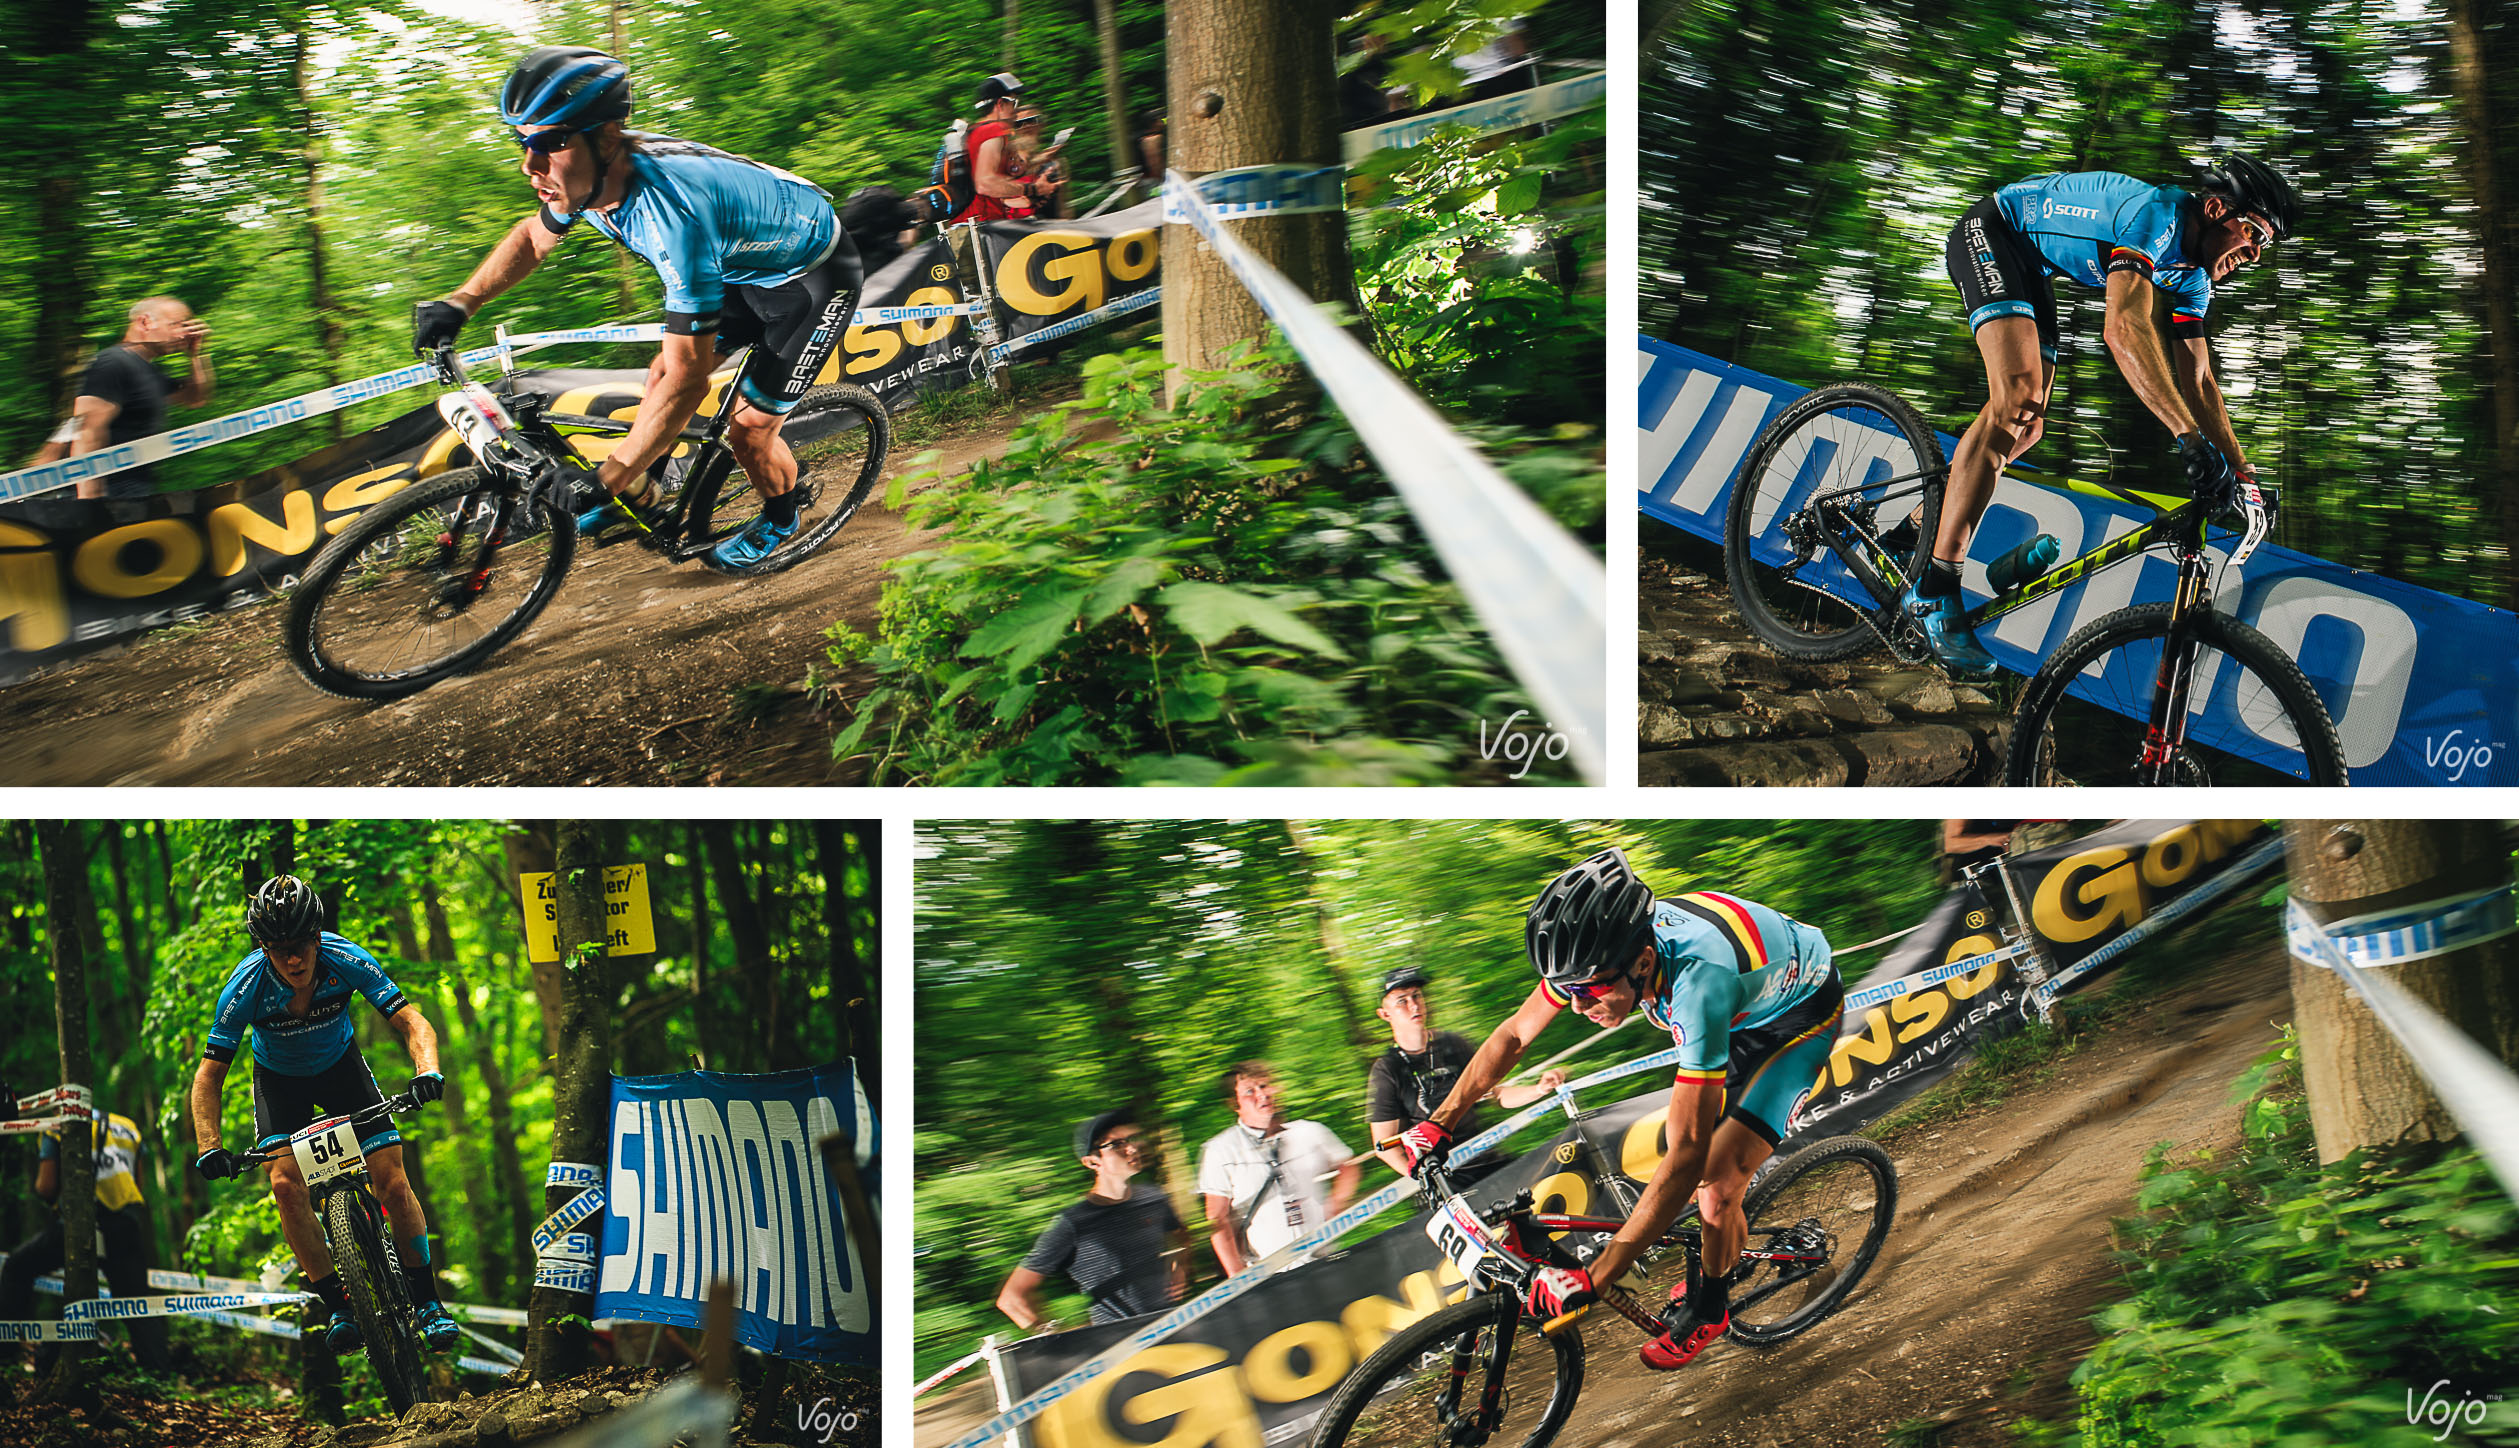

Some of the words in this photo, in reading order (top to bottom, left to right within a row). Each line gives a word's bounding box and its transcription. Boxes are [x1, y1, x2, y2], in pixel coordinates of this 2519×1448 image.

[2053, 204, 2099, 220] SCOTT
[1970, 217, 2005, 295] BAETEMAN
[880, 306, 954, 322] SHIMANO
[1024, 313, 1096, 345] SHIMANO
[784, 289, 848, 394] BAETEMAN
[167, 400, 306, 455] SHIMANO
[332, 947, 383, 979] BAETEMAN
[1921, 953, 1996, 986] SHIMANO
[2073, 929, 2144, 974] SHIMANO
[219, 974, 255, 1025] BAETEMAN
[1840, 1090, 1859, 1106] &
[1867, 990, 2015, 1091] ACTIVEWEAR
[308, 1130, 344, 1165] 54
[598, 1097, 871, 1334] SHIMANO
[1438, 1223, 1467, 1267] 69
[164, 1295, 244, 1313] SHIMANO
